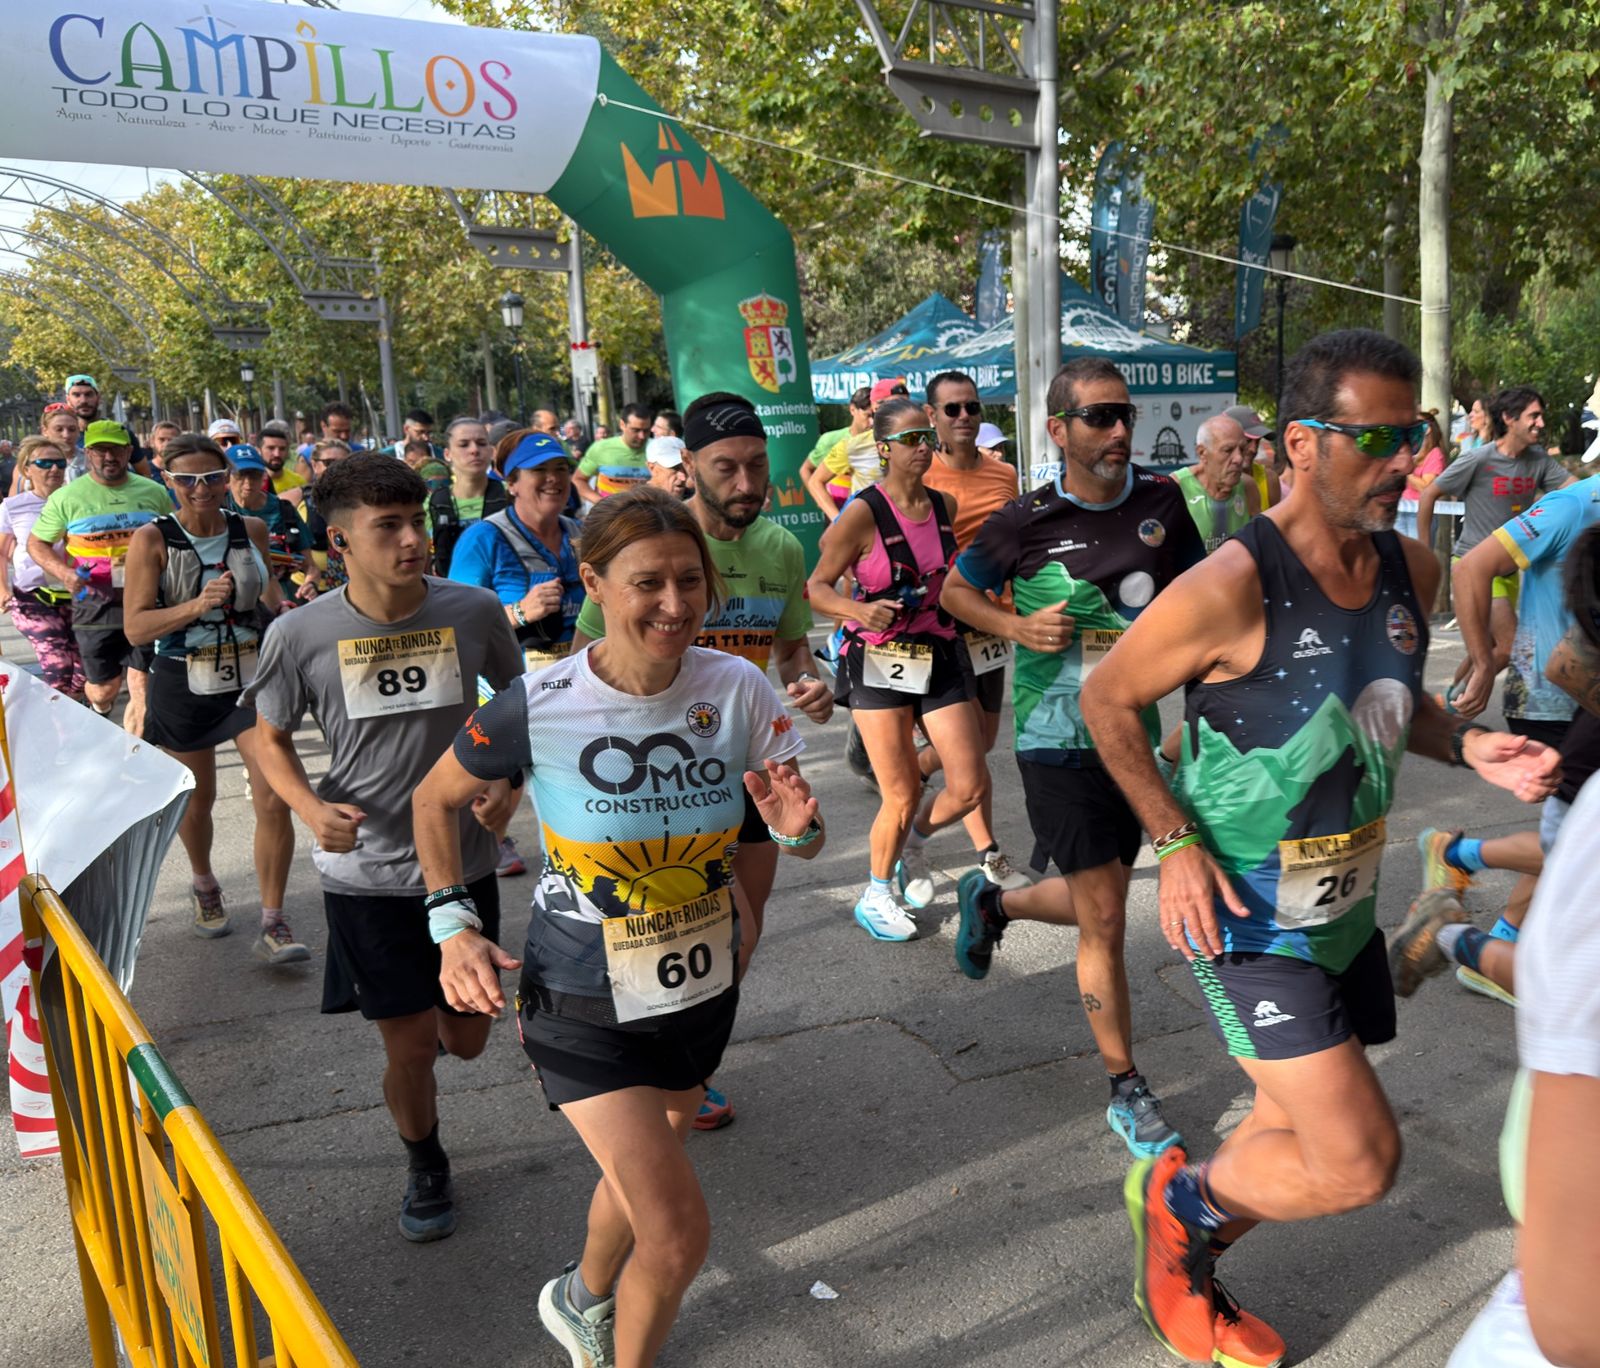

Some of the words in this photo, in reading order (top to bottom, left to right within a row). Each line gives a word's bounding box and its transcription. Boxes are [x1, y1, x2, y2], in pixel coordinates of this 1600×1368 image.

[49, 14, 518, 121] CAMPILLOS
[52, 87, 168, 112] TODO
[183, 98, 230, 117] LO
[243, 104, 320, 126] QUE
[333, 111, 516, 140] NECESITAS
[56, 106, 93, 122] Agua
[116, 111, 187, 129] Naturaleza
[208, 120, 236, 133] Aire
[253, 122, 288, 137] Motor
[308, 127, 372, 144] Patrimonio
[391, 134, 431, 149] Deporte
[977, 365, 1001, 389] BIKE
[1161, 363, 1173, 385] 9
[1176, 363, 1214, 386] BIKE
[354, 638, 393, 656] NUNCA
[393, 639, 401, 650] TE
[400, 630, 442, 650] RINDAS
[981, 640, 1008, 661] 121
[220, 665, 235, 681] 3
[377, 666, 427, 696] 89
[889, 663, 905, 680] 2
[585, 787, 733, 814] CONSTRUCCION
[1314, 867, 1358, 907] 26
[625, 910, 674, 938] NUNCA
[673, 911, 684, 924] TE
[683, 894, 721, 924] RINDAS
[613, 939, 644, 952] QUEDADA
[645, 930, 678, 947] SOLIDARIA
[657, 942, 712, 989] 60
